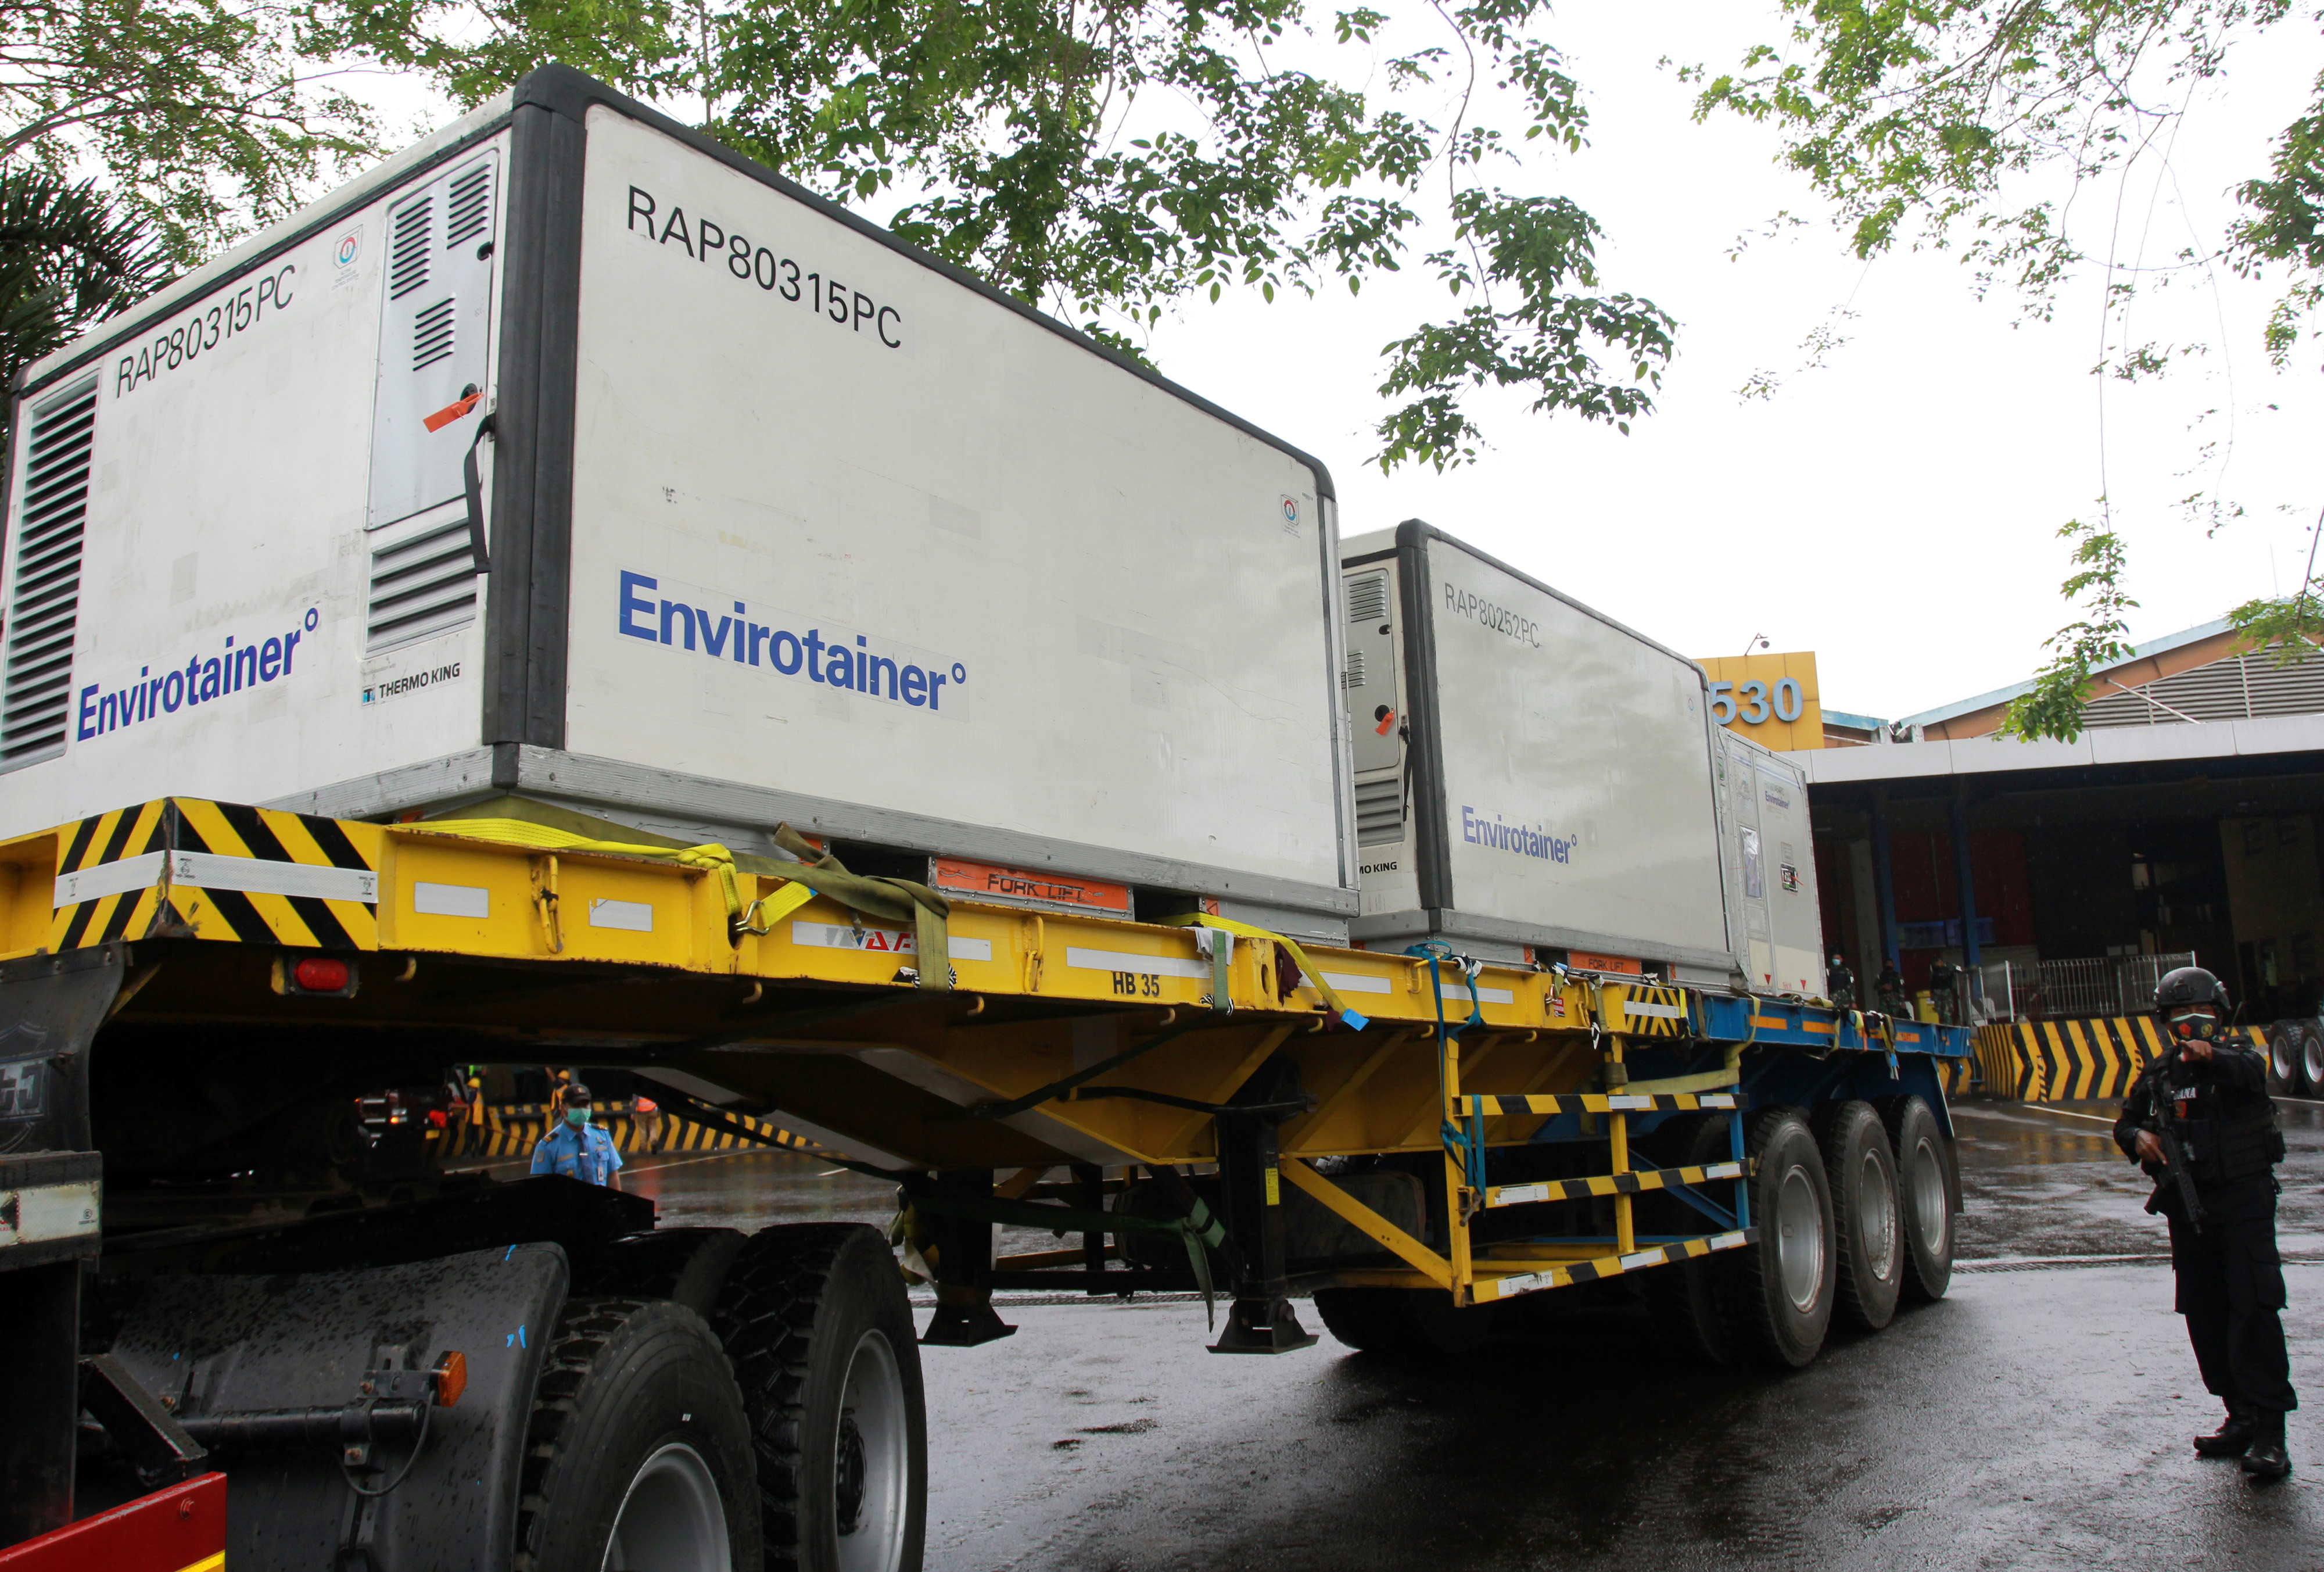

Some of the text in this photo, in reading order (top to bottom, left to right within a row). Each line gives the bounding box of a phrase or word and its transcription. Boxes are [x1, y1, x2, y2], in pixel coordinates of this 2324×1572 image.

[627, 185, 902, 349] RAP80315PC
[117, 264, 295, 398] RAP80315PC
[1444, 582, 1541, 649] RAP80252PC
[379, 672, 428, 698] THERMO
[431, 662, 460, 684] KING
[1710, 677, 1803, 725] 530
[1373, 861, 1397, 872] KING
[988, 873, 1085, 902] FORK LIFT
[1589, 958, 1624, 972] FORK LIFT
[1113, 971, 1160, 998] HB 35
